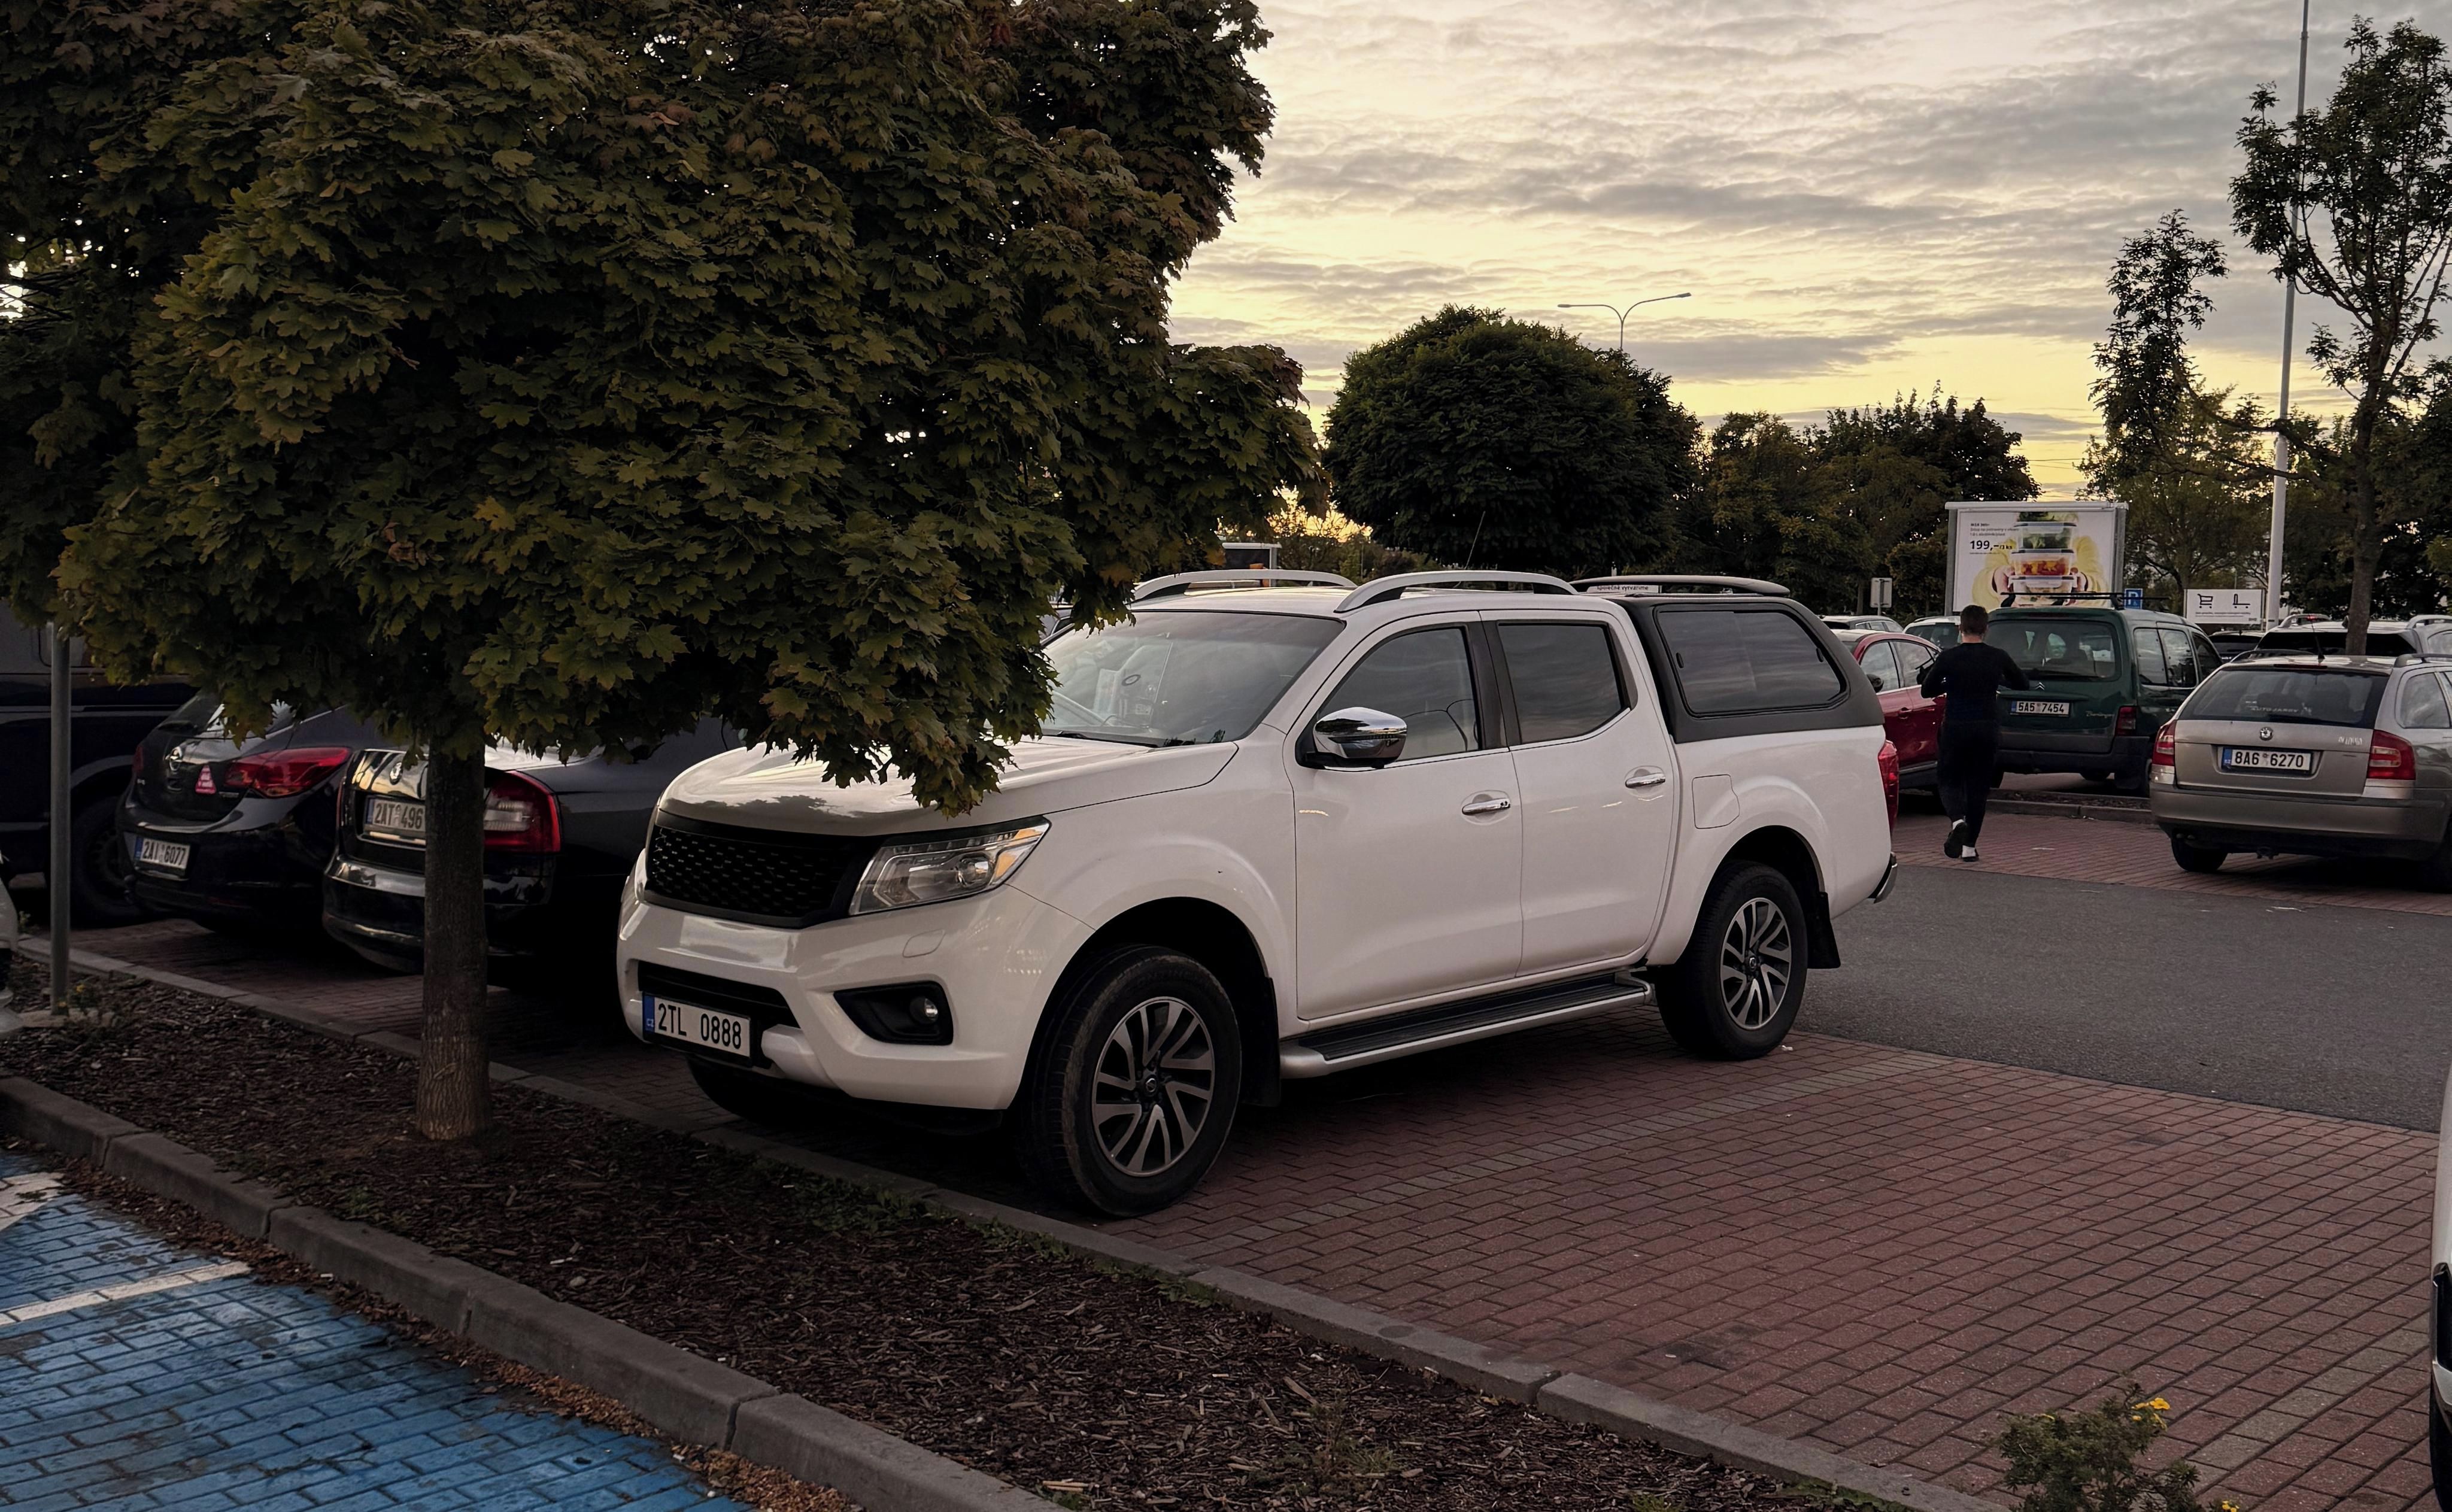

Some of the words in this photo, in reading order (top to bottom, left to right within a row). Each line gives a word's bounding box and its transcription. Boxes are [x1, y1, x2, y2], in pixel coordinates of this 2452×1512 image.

[2128, 591, 2138, 605] P
[2018, 702, 2035, 712] 5A5
[2041, 703, 2065, 713] 7454
[2235, 751, 2260, 766] 8A6
[2270, 753, 2304, 768] 6270
[374, 803, 395, 825] 2AT
[401, 806, 424, 830] 496
[164, 845, 187, 866] 6077
[658, 1003, 687, 1037] 2TL
[700, 1013, 742, 1050] 0888
